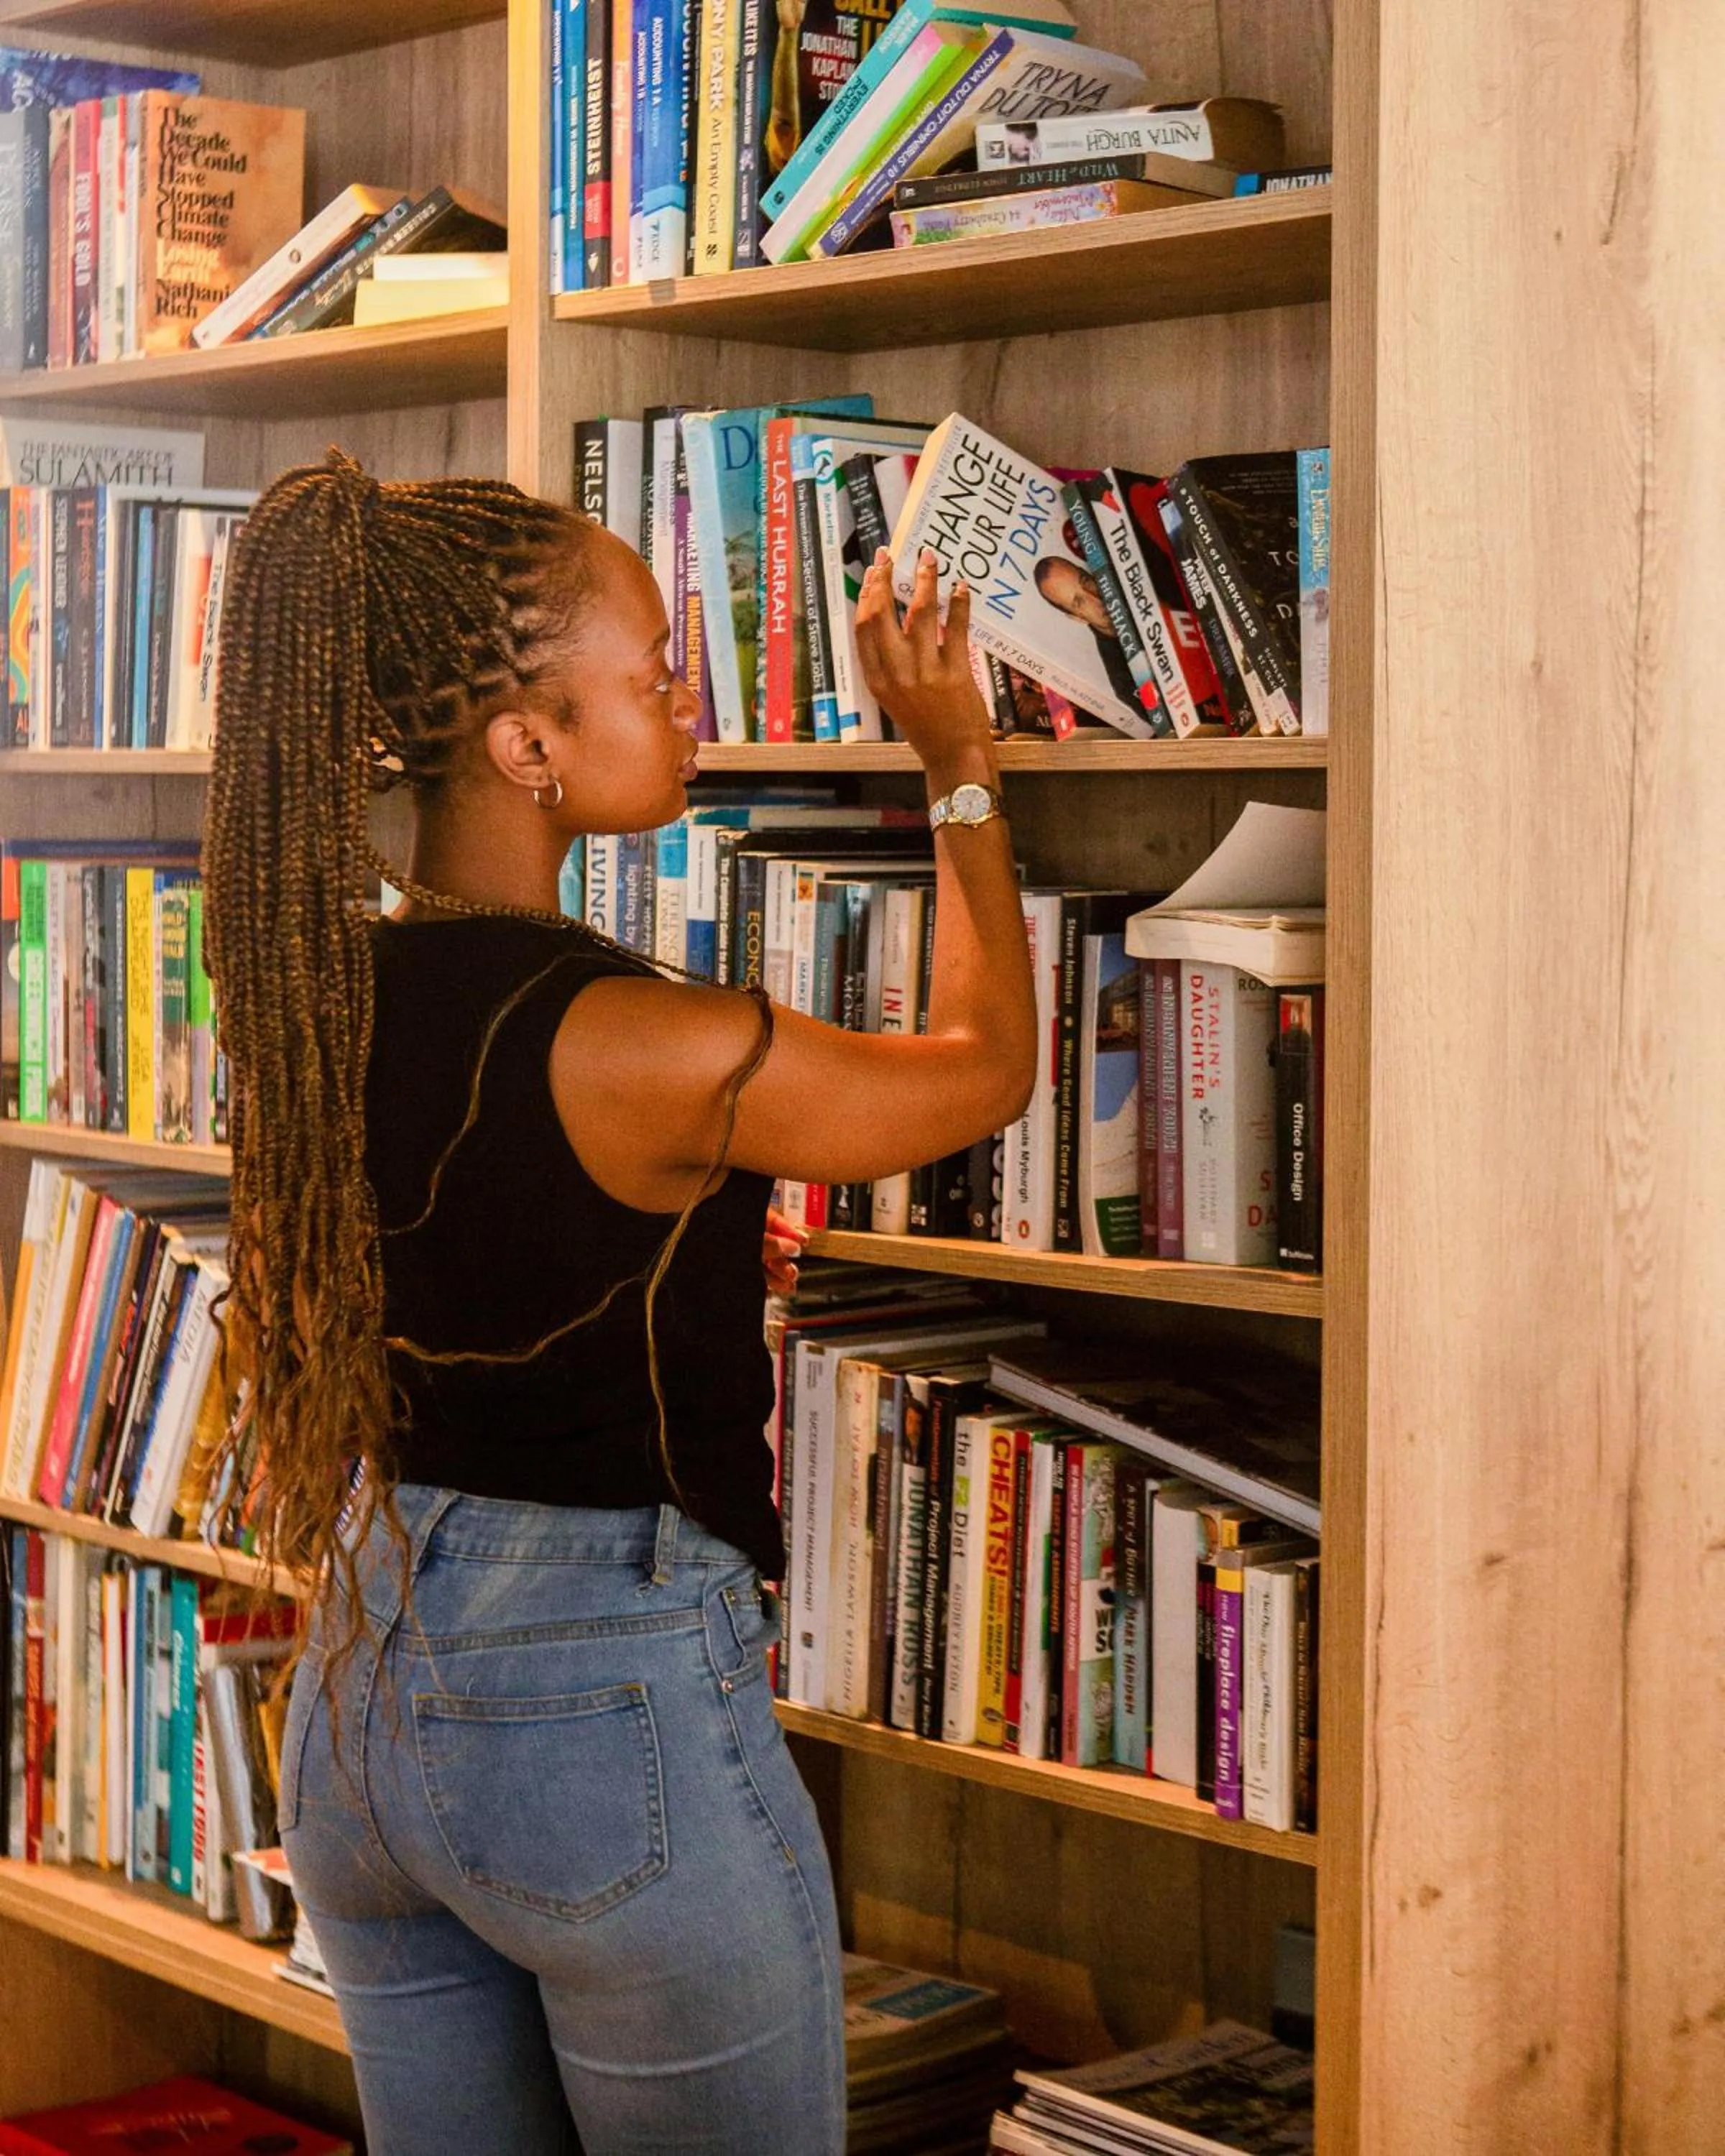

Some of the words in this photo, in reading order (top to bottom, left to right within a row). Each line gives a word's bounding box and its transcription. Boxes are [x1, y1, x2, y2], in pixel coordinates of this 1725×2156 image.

[800, 32, 858, 59] JONATHAN
[835, 15, 860, 37] THE
[650, 17, 663, 86] ACCOUNTING
[968, 48, 1000, 83] TRYNA
[710, 47, 726, 111] PARK
[1011, 61, 1113, 106] TRYNA
[161, 106, 198, 129] The
[586, 58, 604, 176] STEINHEIST
[820, 82, 870, 145] EVERYTHING
[934, 96, 959, 123] TOIT
[978, 87, 1030, 116] DU
[159, 128, 230, 153] Decade
[712, 116, 722, 139] An
[895, 119, 939, 167] OMNIBUS
[1085, 128, 1143, 152] BURGH
[1147, 121, 1201, 146] ANITA
[158, 147, 190, 167] We
[189, 147, 247, 174] Could
[158, 162, 206, 187] Have
[707, 143, 722, 188] Empty
[1017, 166, 1068, 185] HEART
[1082, 162, 1120, 178] WILD
[1265, 172, 1332, 193] JONATHAN
[74, 172, 92, 233] FOOL'S
[157, 184, 235, 211] Stopped
[157, 201, 230, 229] Climate
[707, 192, 722, 235] Coast
[156, 219, 228, 249] Change
[74, 240, 92, 287] GOLD
[155, 279, 231, 303] Nathani
[155, 296, 198, 318] Rich
[776, 433, 785, 455] THE
[19, 447, 174, 489] SULAMITH
[584, 439, 604, 526] NELSO
[772, 460, 790, 517] LAST
[983, 458, 1026, 516] LIFE
[1008, 479, 1057, 556] DAYS
[1065, 498, 1100, 556] YOUNG
[1106, 519, 1138, 563] The
[771, 528, 790, 633] HURRAH
[800, 558, 817, 604] Secrets
[999, 551, 1029, 581] 7
[1096, 573, 1114, 599] THE
[1175, 557, 1213, 610] JAMES
[1182, 495, 1213, 545] TOUCH
[1215, 563, 1259, 638] DARKNESS
[985, 578, 1022, 620] IN
[1121, 562, 1159, 621] Black
[686, 595, 702, 692] MANAGEMENT
[806, 623, 820, 656] Steve
[1104, 596, 1140, 659] SHACK
[810, 660, 824, 688] Jobs
[1015, 653, 1046, 676] DAYS
[1142, 621, 1180, 683] Swan
[624, 864, 642, 922] lighting
[624, 925, 640, 946] by
[1067, 918, 1077, 956] Steven
[1066, 960, 1077, 1004] Johnson
[1064, 1038, 1075, 1076] Where
[1190, 974, 1205, 1100] DAUGHTER
[1208, 985, 1221, 1089] STALIN'S
[1062, 1079, 1073, 1107] Good
[1062, 1110, 1072, 1141] Ideas
[1292, 1102, 1305, 1146] Office
[1059, 1144, 1072, 1176] Come
[1290, 1151, 1305, 1202] Design
[1059, 1179, 1070, 1208] From
[808, 1410, 819, 1478] SUCCESSFUL
[852, 1423, 862, 1453] EAT
[956, 1432, 972, 1466] the
[806, 1481, 816, 1532] PROJECT
[850, 1486, 860, 1529] HOW
[986, 1434, 1012, 1578] CHEATS!
[904, 1475, 926, 1611] JONATHAN
[926, 1500, 941, 1560] Project
[952, 1511, 970, 1558] Diet
[804, 1534, 815, 1613] MANAGEMENT
[845, 1541, 857, 1620] LAWSON
[921, 1562, 939, 1668] Management
[1123, 1607, 1138, 1646] MARK
[842, 1628, 854, 1702] NIGELLA
[901, 1618, 920, 1687] ROSS
[1217, 1625, 1236, 1710] fireplace
[1123, 1654, 1138, 1715] HADDON
[1216, 1717, 1233, 1782] design
